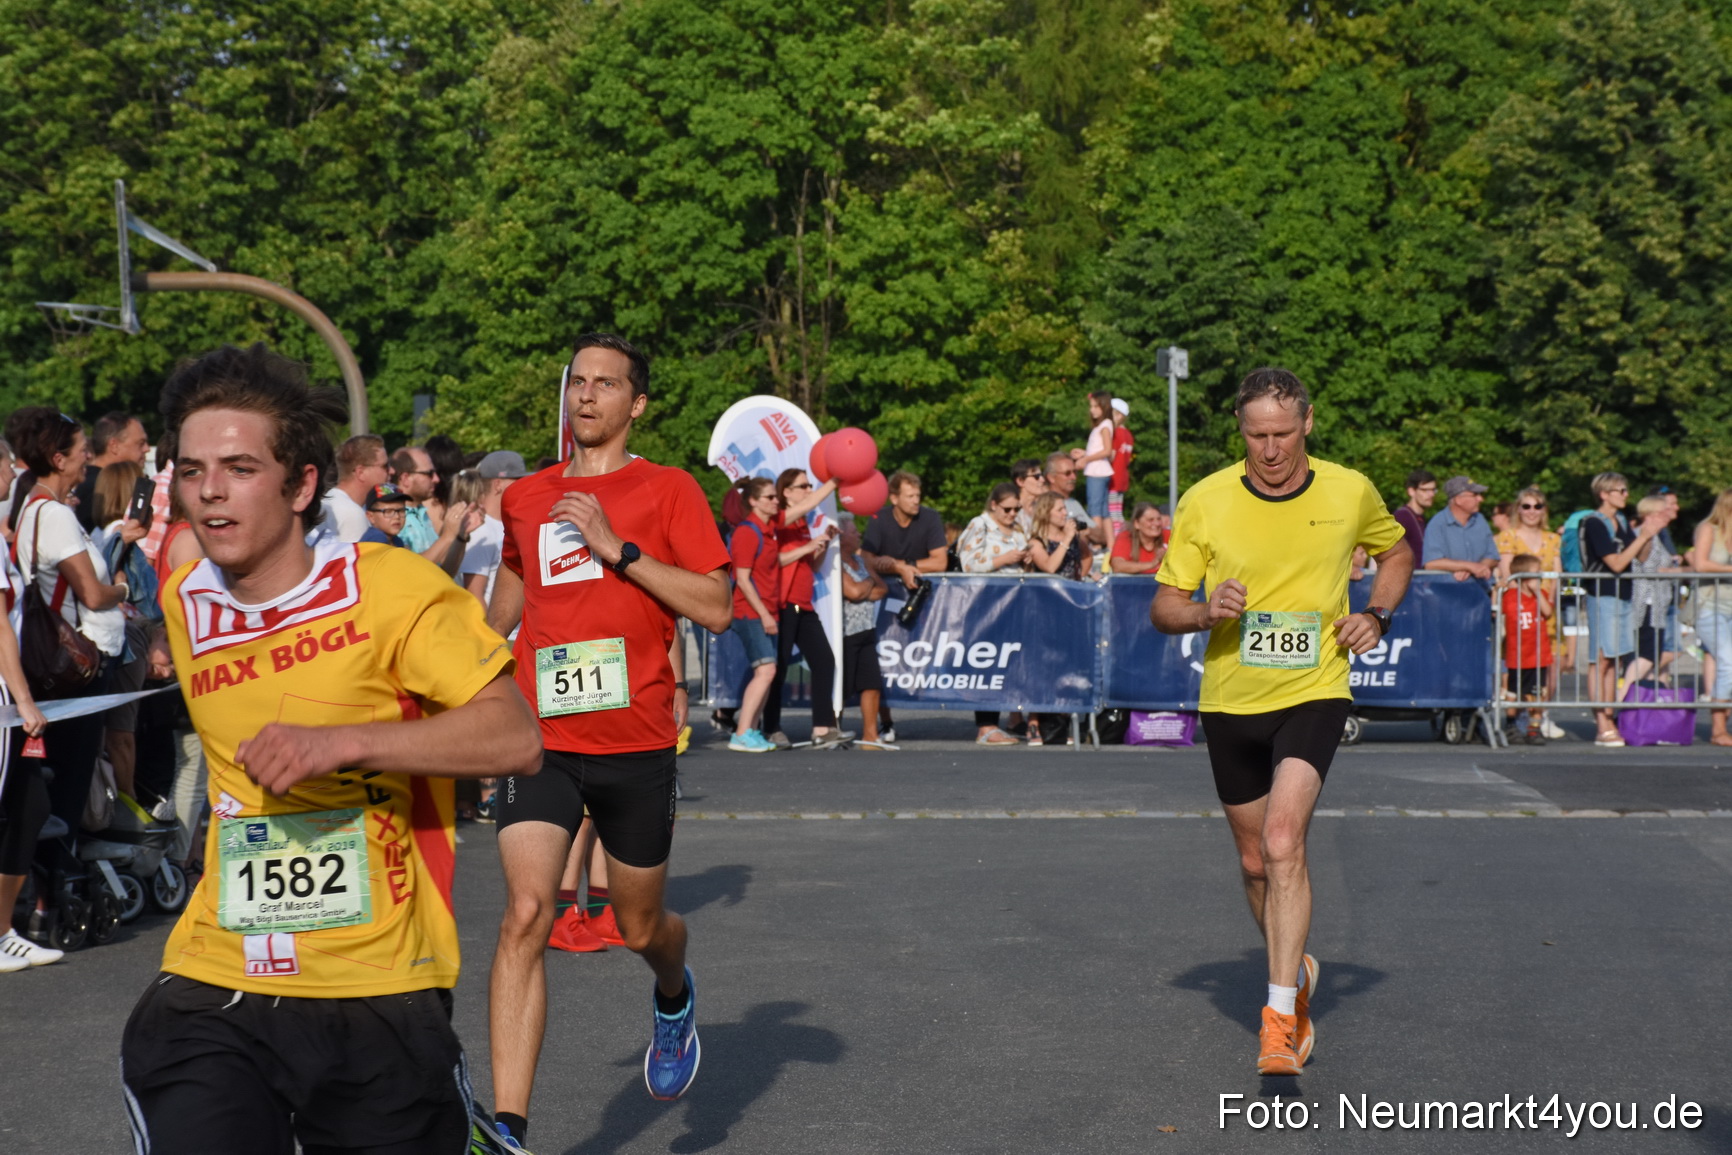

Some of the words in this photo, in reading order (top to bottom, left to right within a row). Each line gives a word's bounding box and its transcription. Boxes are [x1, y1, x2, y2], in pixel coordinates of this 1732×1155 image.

[561, 553, 580, 569] DEHN
[876, 631, 1022, 668] scher
[1249, 631, 1309, 653] 2188
[191, 655, 260, 699] MAX
[269, 619, 371, 674] BÖGL
[554, 665, 602, 695] 511
[884, 673, 1005, 690] TOMOBILE
[551, 693, 585, 704] Kürzinger
[587, 691, 612, 701] Jürgen
[327, 840, 357, 851] 2019
[238, 853, 347, 902] 1582
[259, 901, 283, 913] Graf
[285, 898, 325, 911] Marcel
[275, 912, 318, 922] Bauservice
[321, 908, 346, 918] GmbH
